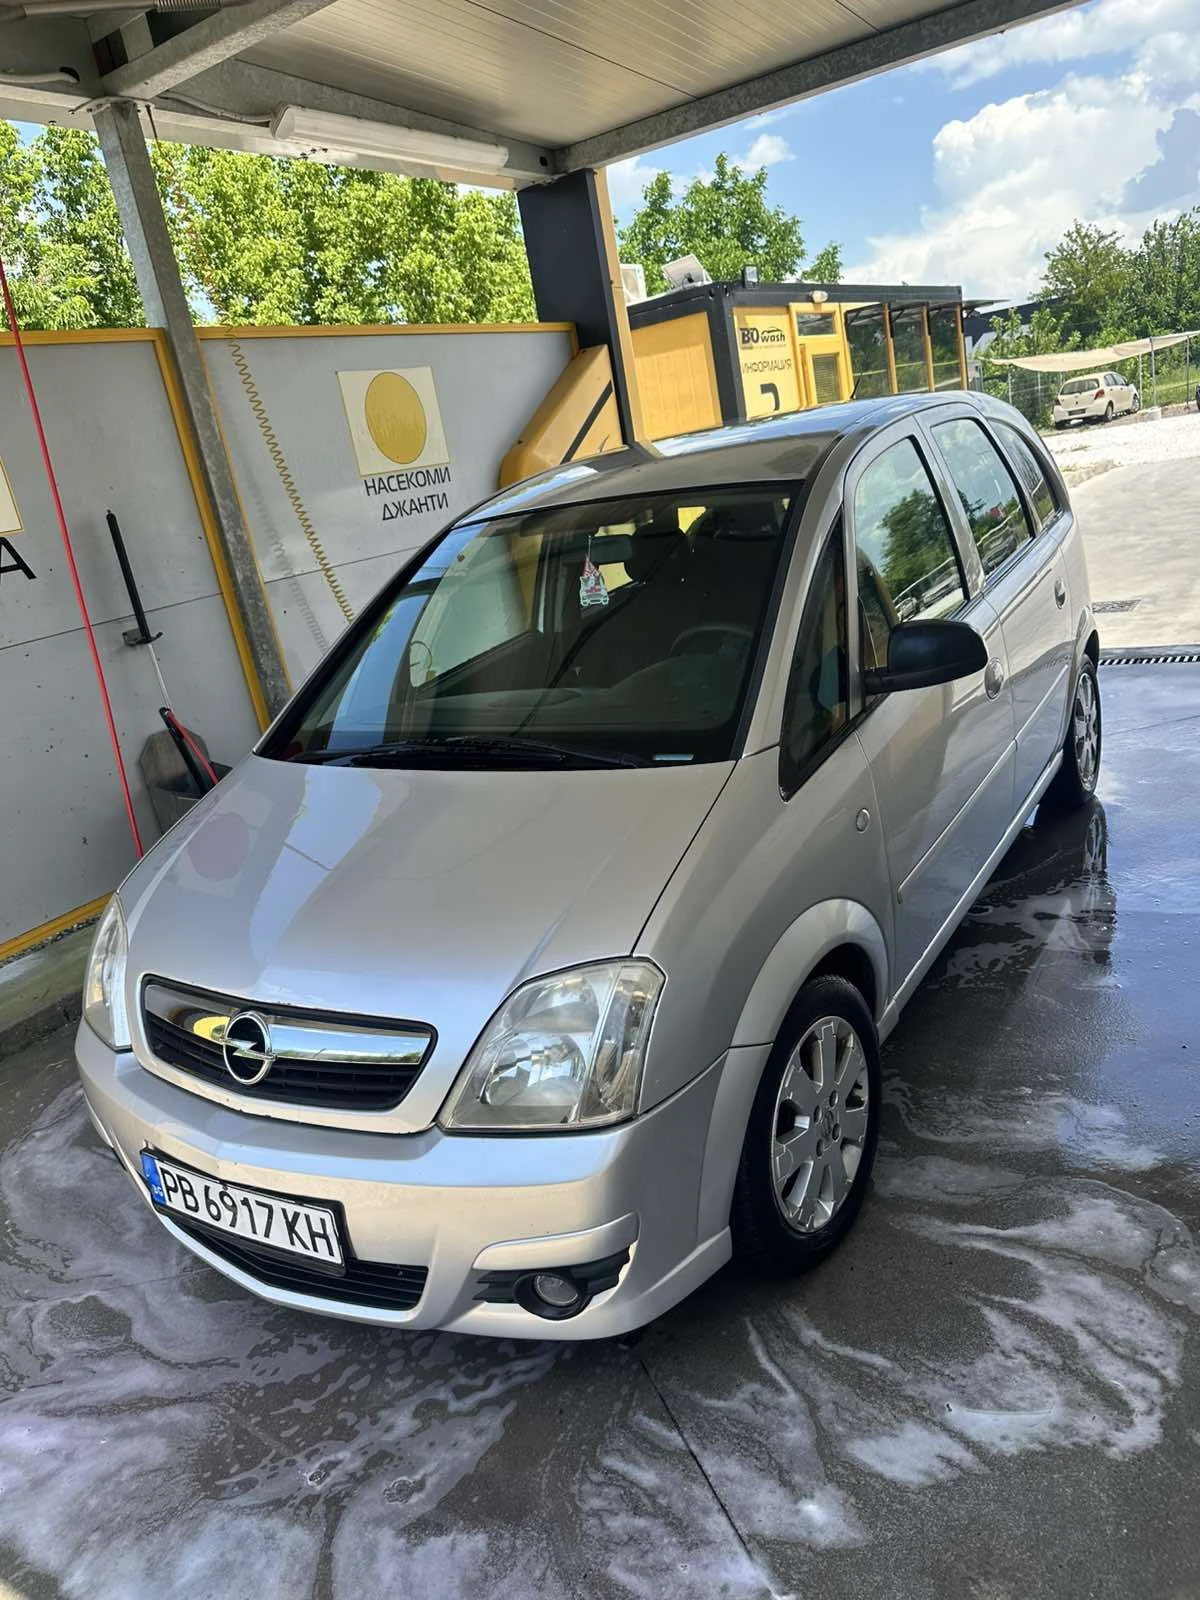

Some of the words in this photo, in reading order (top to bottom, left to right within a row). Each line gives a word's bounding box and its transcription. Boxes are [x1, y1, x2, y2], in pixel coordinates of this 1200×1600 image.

[761, 332, 786, 344] wash
[364, 467, 452, 497] НАСЕКОМИ
[382, 492, 449, 521] ДЖАНТИ
[159, 1166, 200, 1213] PB
[204, 1185, 274, 1239] 6917
[281, 1207, 335, 1257] KH
